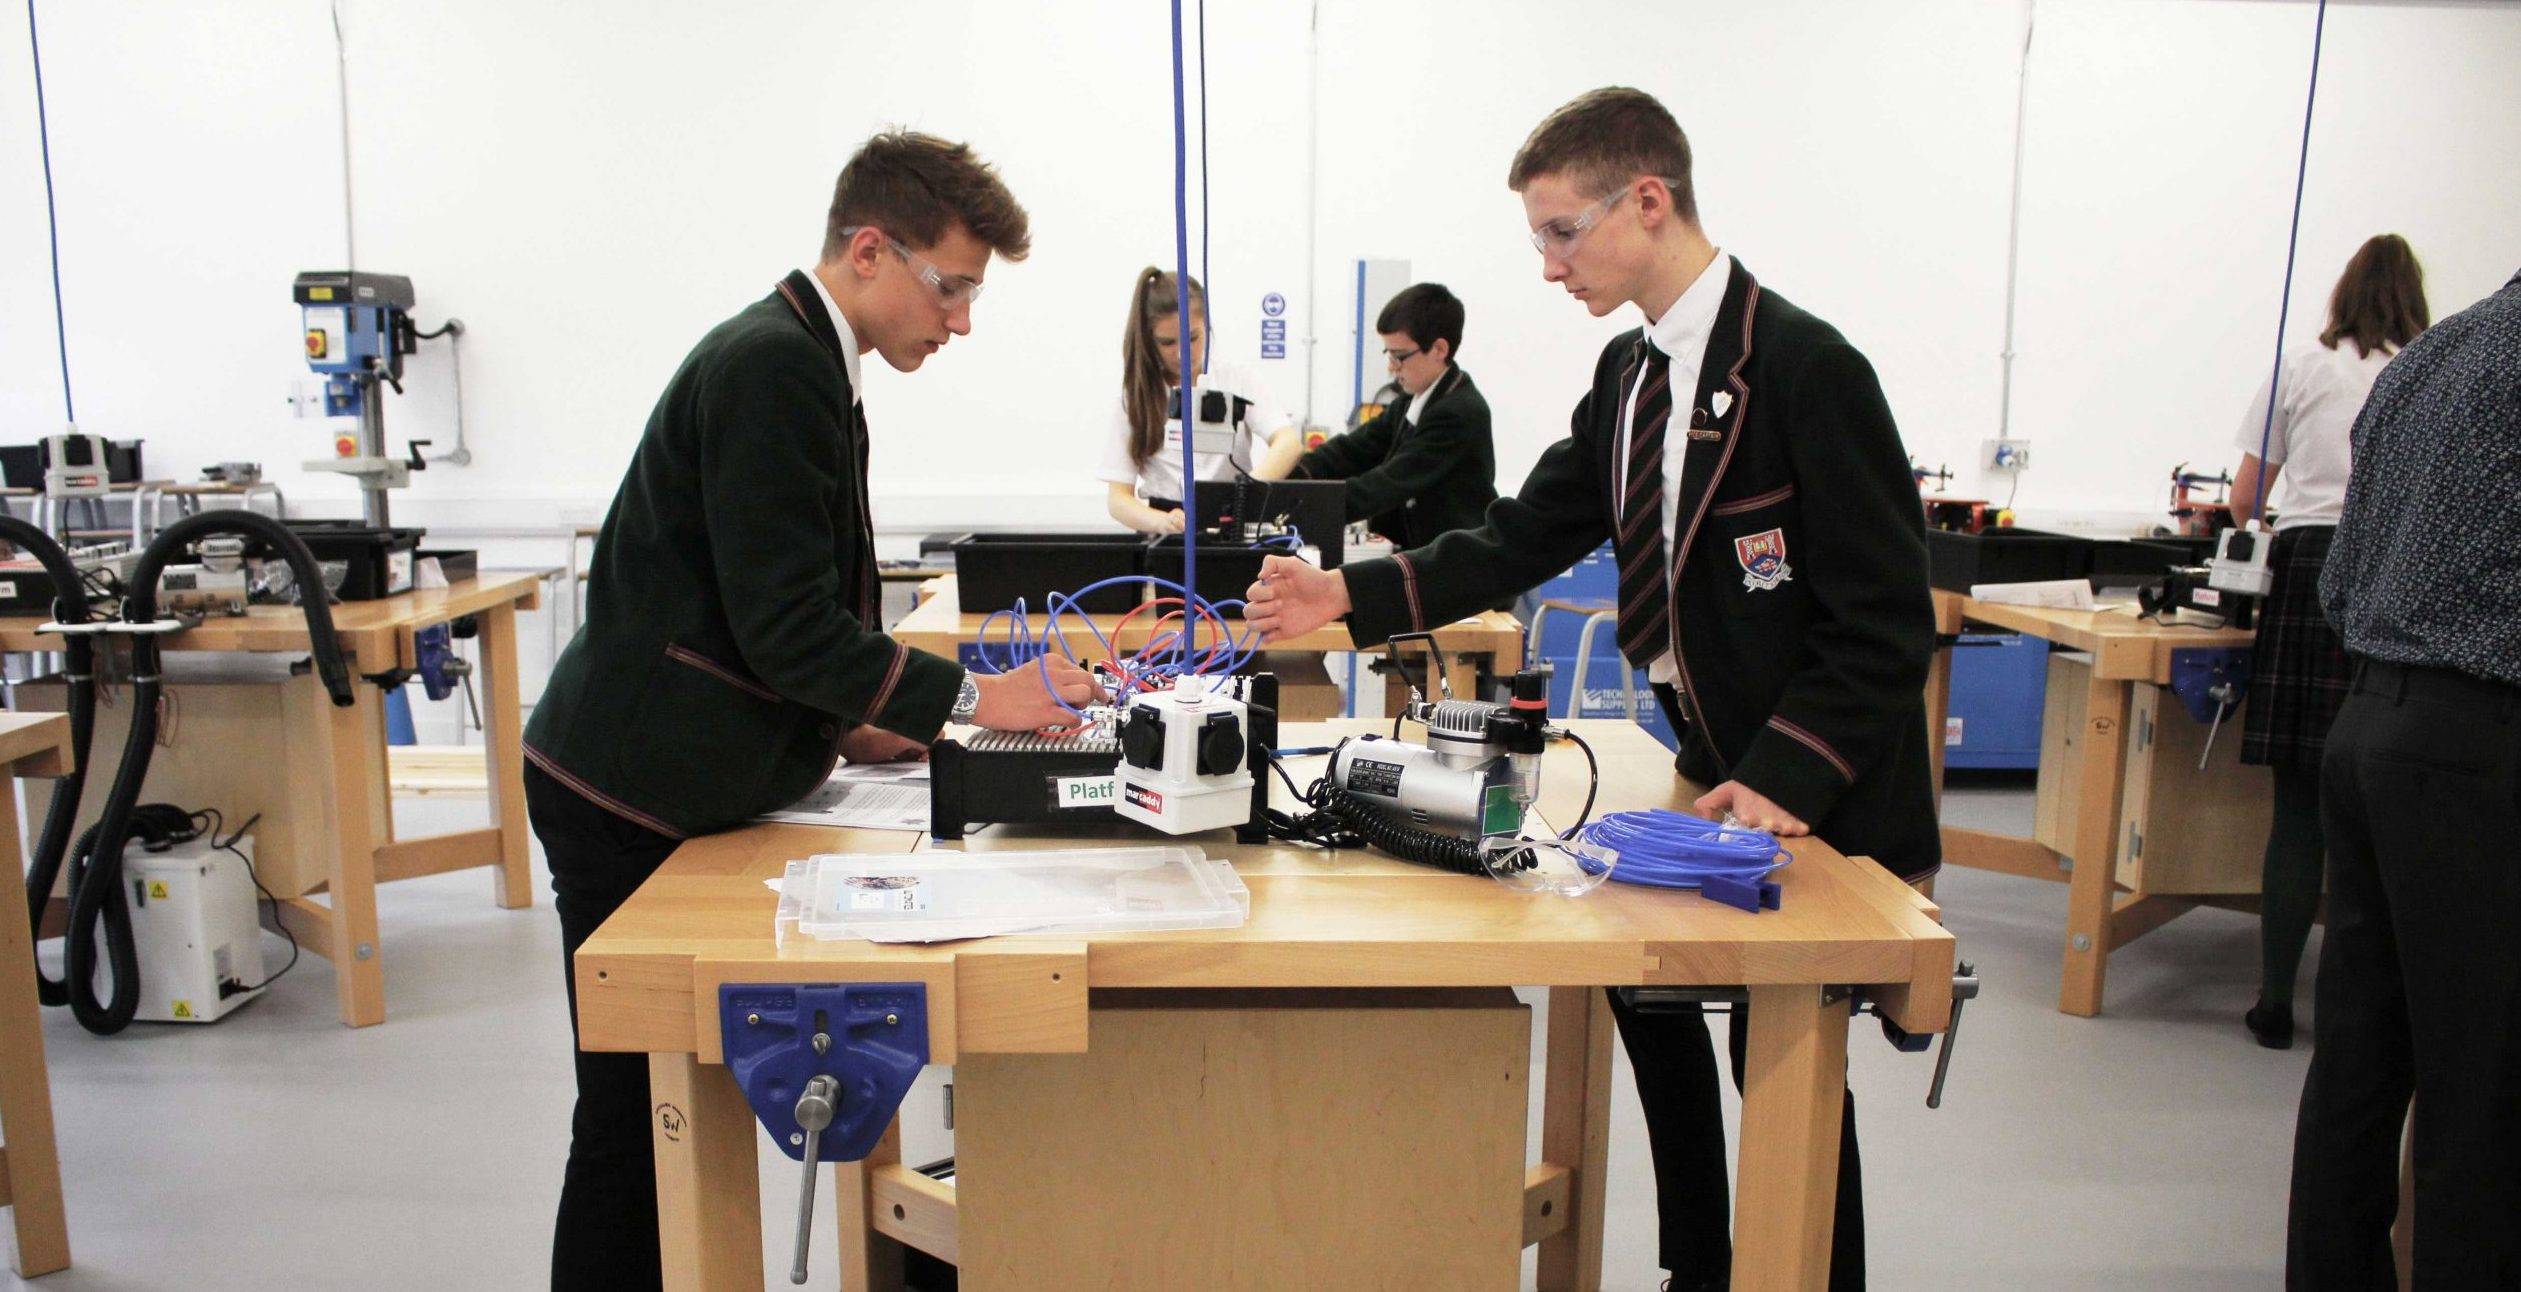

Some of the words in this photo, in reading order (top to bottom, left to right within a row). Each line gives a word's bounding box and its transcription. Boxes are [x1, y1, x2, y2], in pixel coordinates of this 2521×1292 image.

[1602, 689, 1655, 699] TECHLOGY
[1602, 699, 1638, 710] SUPPLS
[1641, 699, 1656, 710] LTD
